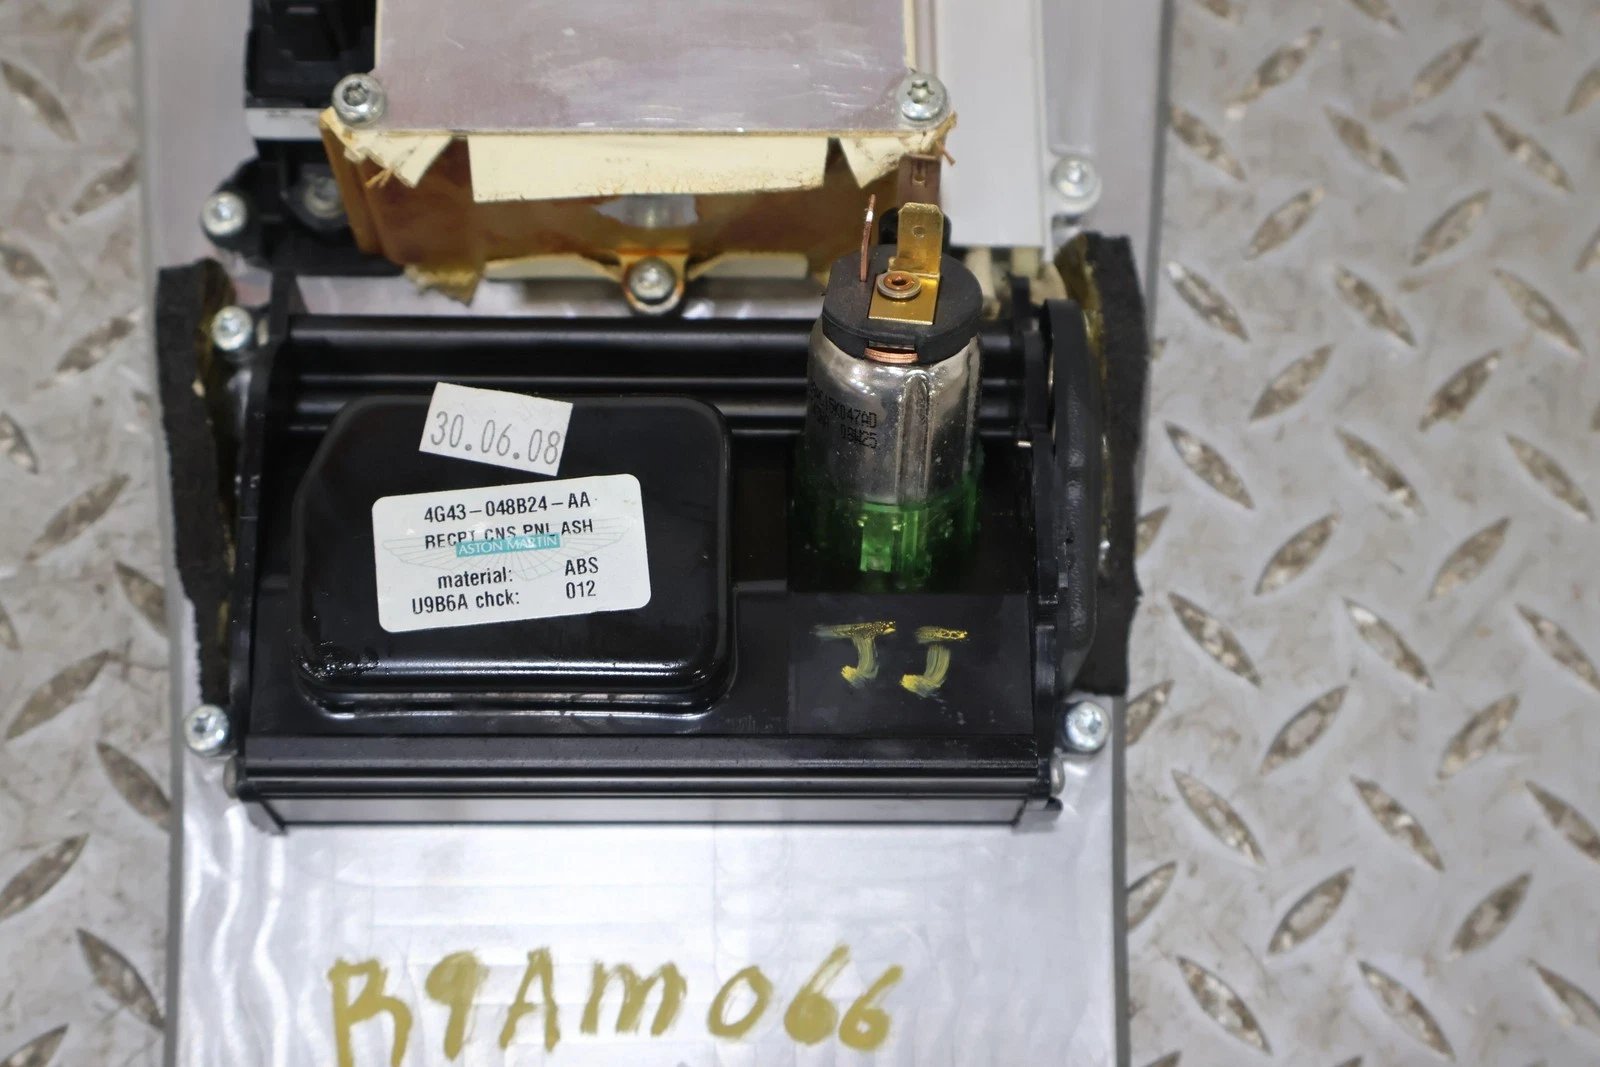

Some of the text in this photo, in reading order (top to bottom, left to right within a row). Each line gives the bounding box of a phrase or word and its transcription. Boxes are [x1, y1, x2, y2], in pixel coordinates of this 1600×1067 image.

[430, 411, 561, 465] 30.06.08
[458, 535, 558, 556] ASTON MARTIN
[484, 526, 517, 543] CNS
[522, 521, 557, 537] PNL
[561, 519, 594, 537] ASH
[437, 556, 599, 590] material: ABS
[412, 580, 597, 615] U9B6A chck: 012
